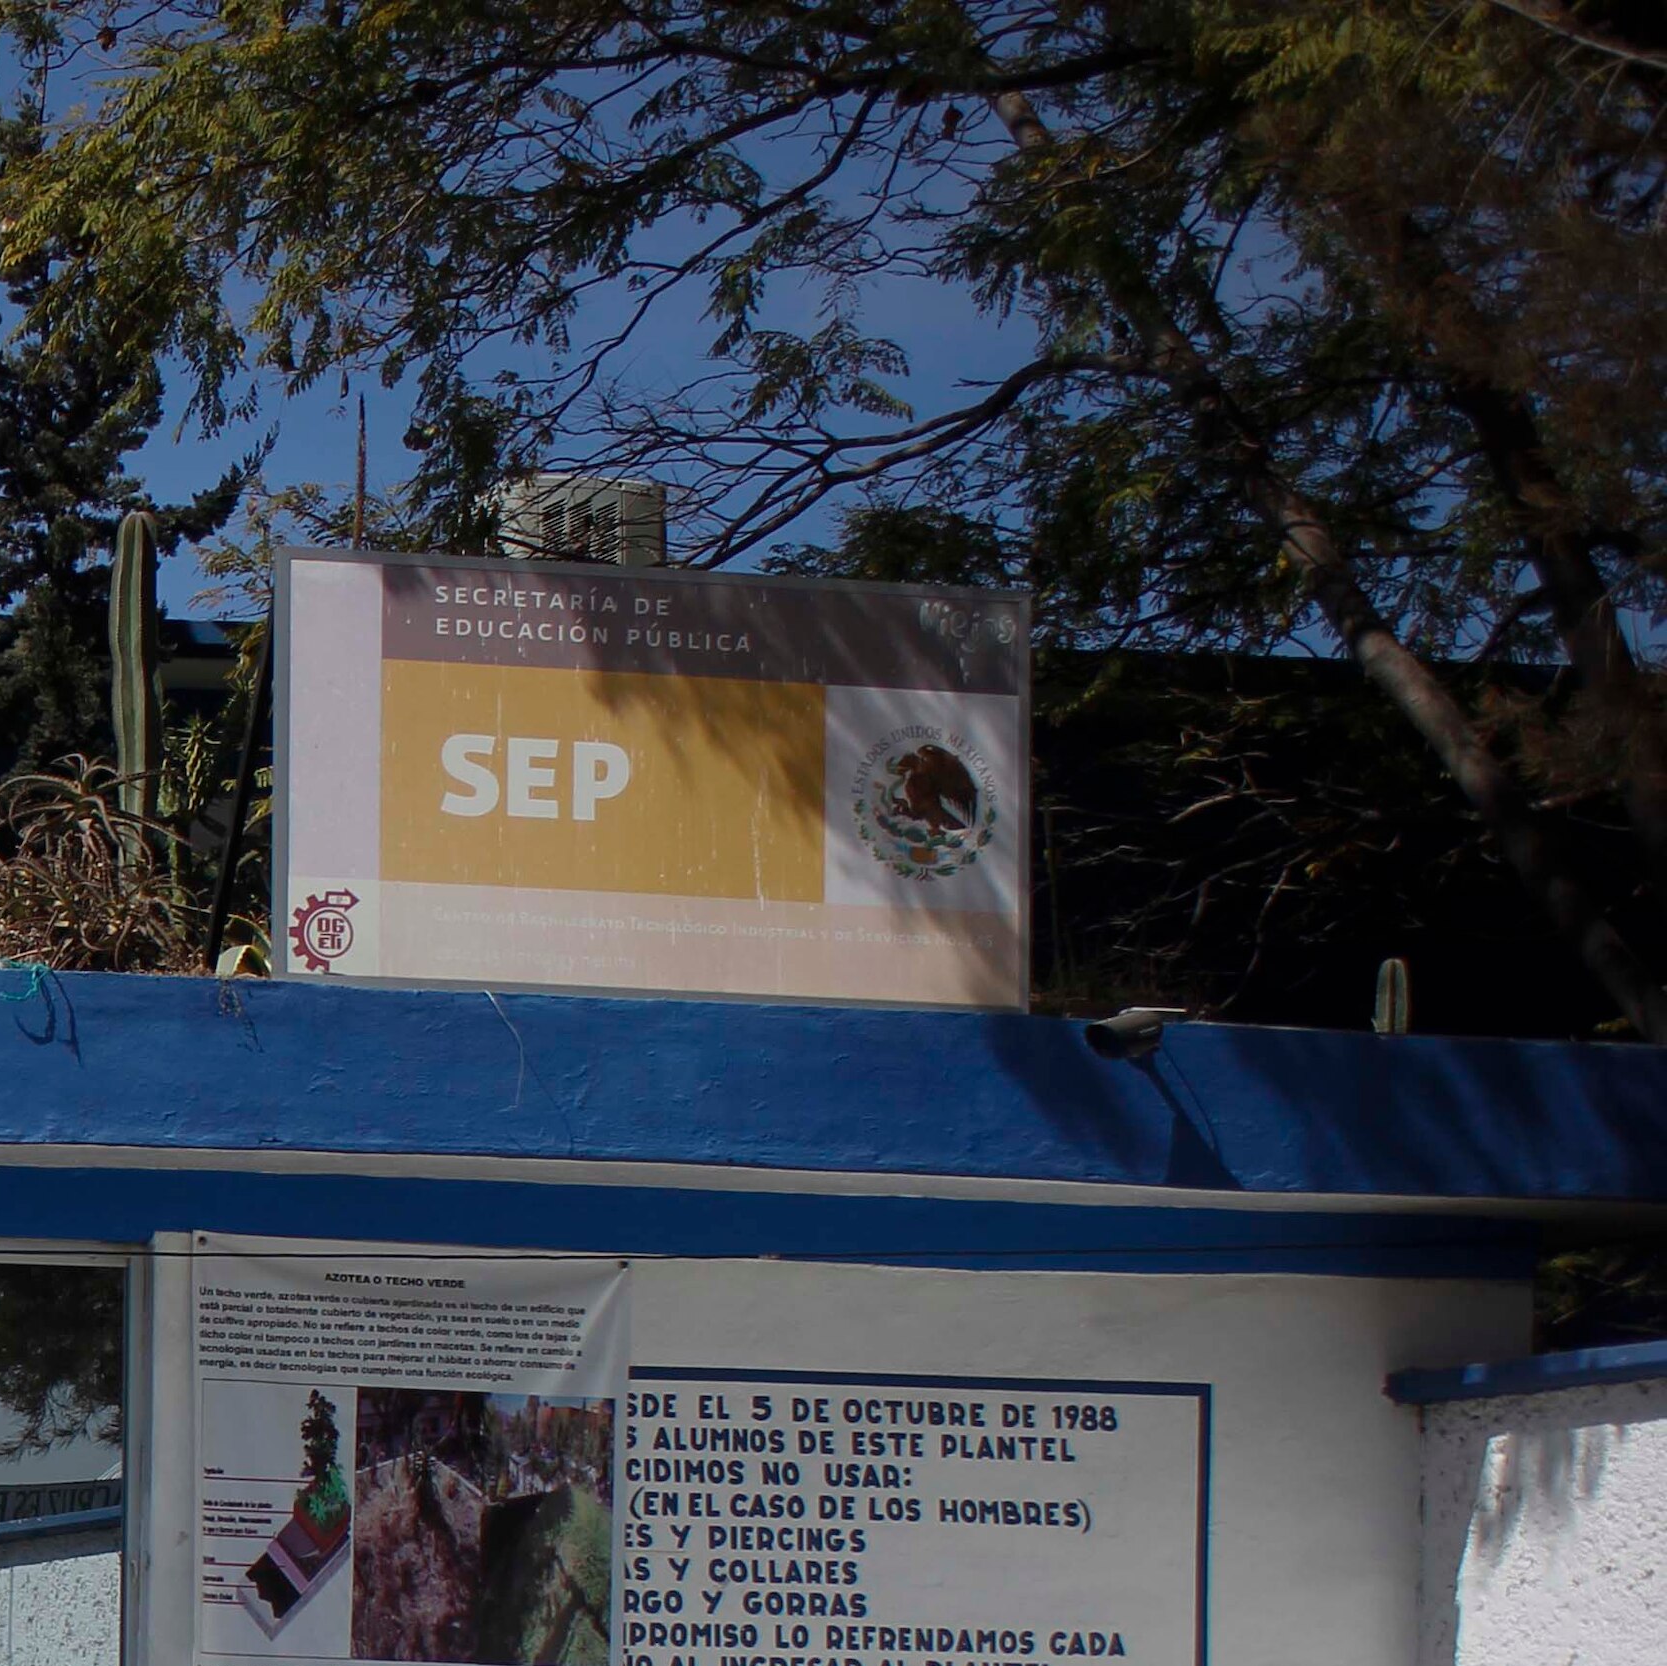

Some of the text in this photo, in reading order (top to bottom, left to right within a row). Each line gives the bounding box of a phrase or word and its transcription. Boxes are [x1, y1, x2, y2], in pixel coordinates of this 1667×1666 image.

[434, 585, 670, 616] SECRETARÍA DE
[435, 617, 751, 653] EDUCACIÓN PÚBLICA
[440, 733, 631, 820] SEP
[851, 725, 999, 804] ESTADOS UNIDOS MEXICANOS
[325, 1273, 371, 1284] AZOTEA
[385, 1276, 424, 1287] TECHO
[428, 1278, 465, 1289] VERDE
[699, 1394, 731, 1420] EL
[751, 1395, 773, 1422] 5
[792, 1397, 830, 1424] DE
[843, 1398, 986, 1428] OCTUBRE
[1002, 1403, 1037, 1429] DE
[1052, 1404, 1119, 1432] 1988
[653, 1426, 786, 1454] ALUMNOS
[798, 1430, 835, 1455] DE
[852, 1431, 924, 1458] ESTE
[941, 1434, 1077, 1463] PLANTEL
[761, 1461, 801, 1486] NO
[824, 1463, 912, 1489] USAR:
[688, 1492, 721, 1518] EL
[730, 1493, 807, 1519] CASO
[819, 1495, 856, 1521] DE
[869, 1497, 922, 1522] LOS
[939, 1499, 1092, 1533] HOMBRES)
[670, 1524, 692, 1549] Y
[708, 1525, 867, 1553] PIERCINGS
[623, 1556, 859, 1586] S Y COLLARES
[702, 1590, 724, 1615] Y
[743, 1590, 868, 1619] GORRAS
[622, 1621, 759, 1648] PROMISO
[775, 1624, 810, 1649] LO
[826, 1624, 1036, 1655] REFRENDAMOS
